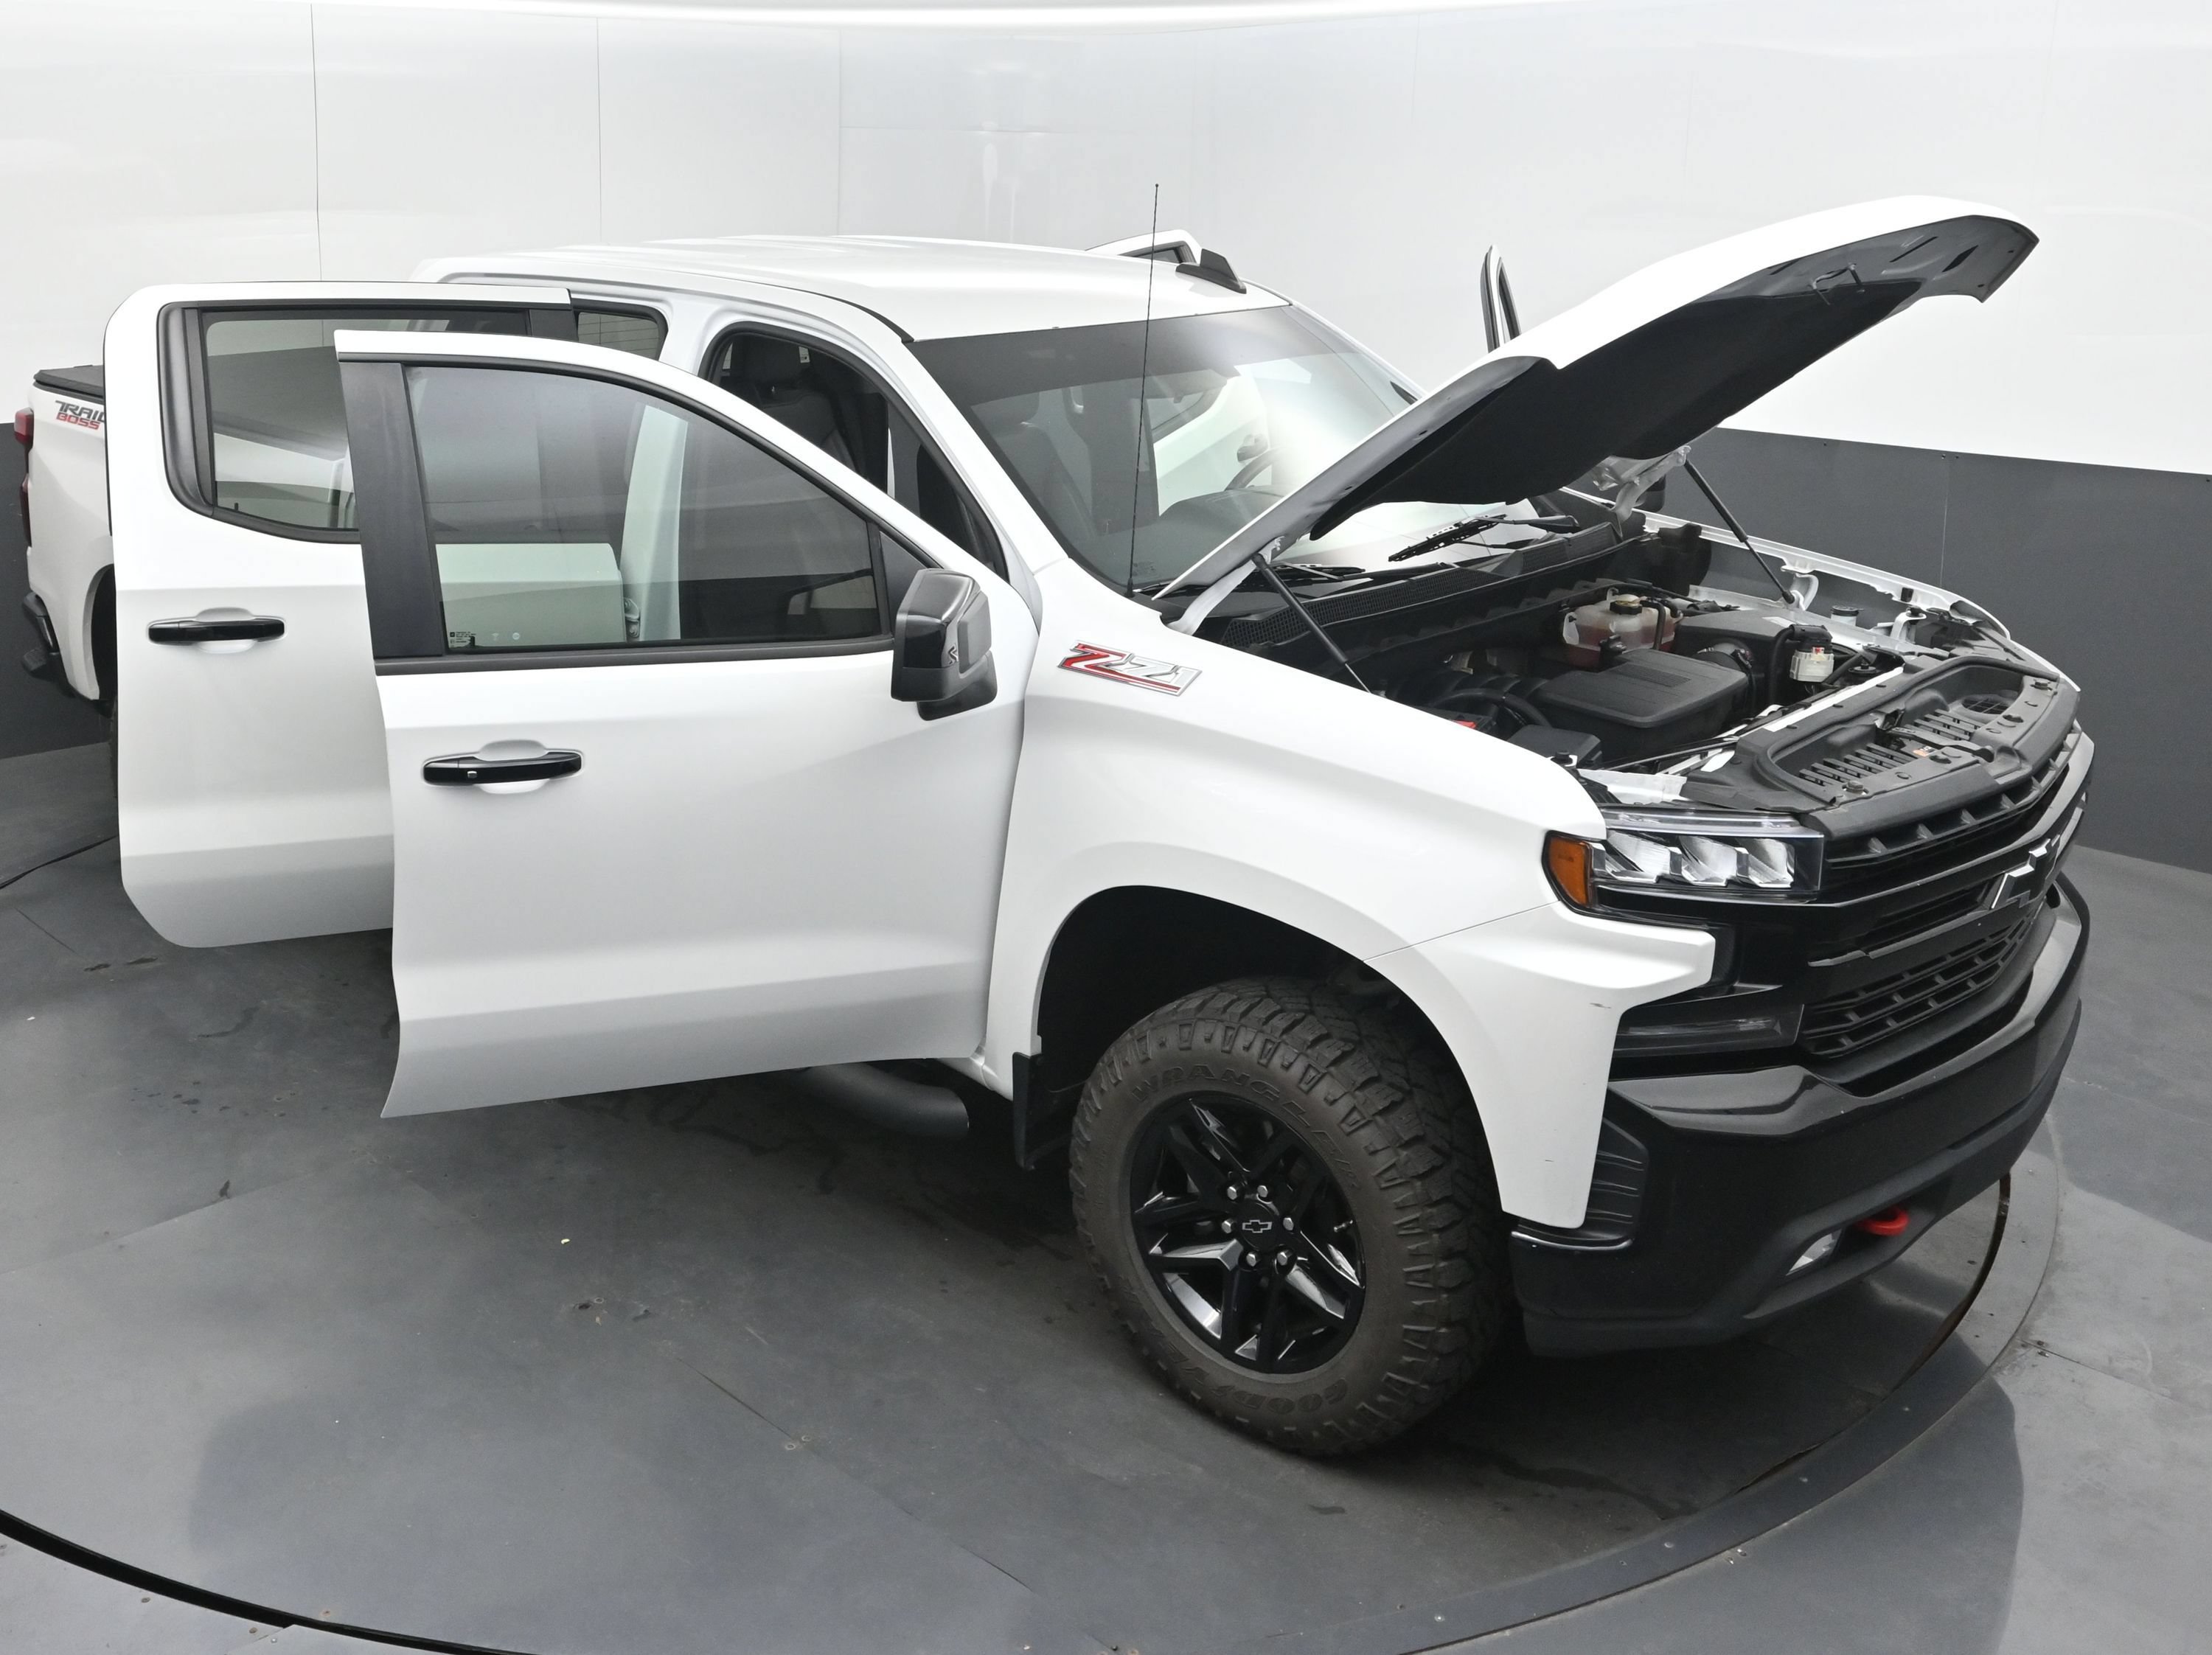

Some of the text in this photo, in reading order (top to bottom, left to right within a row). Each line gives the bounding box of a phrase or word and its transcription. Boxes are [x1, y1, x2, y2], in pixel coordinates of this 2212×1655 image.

[55, 400, 105, 422] TRAIL
[56, 412, 100, 430] BOSS
[1057, 640, 1203, 697] Z71
[1130, 1063, 1360, 1190] WRANGLER
